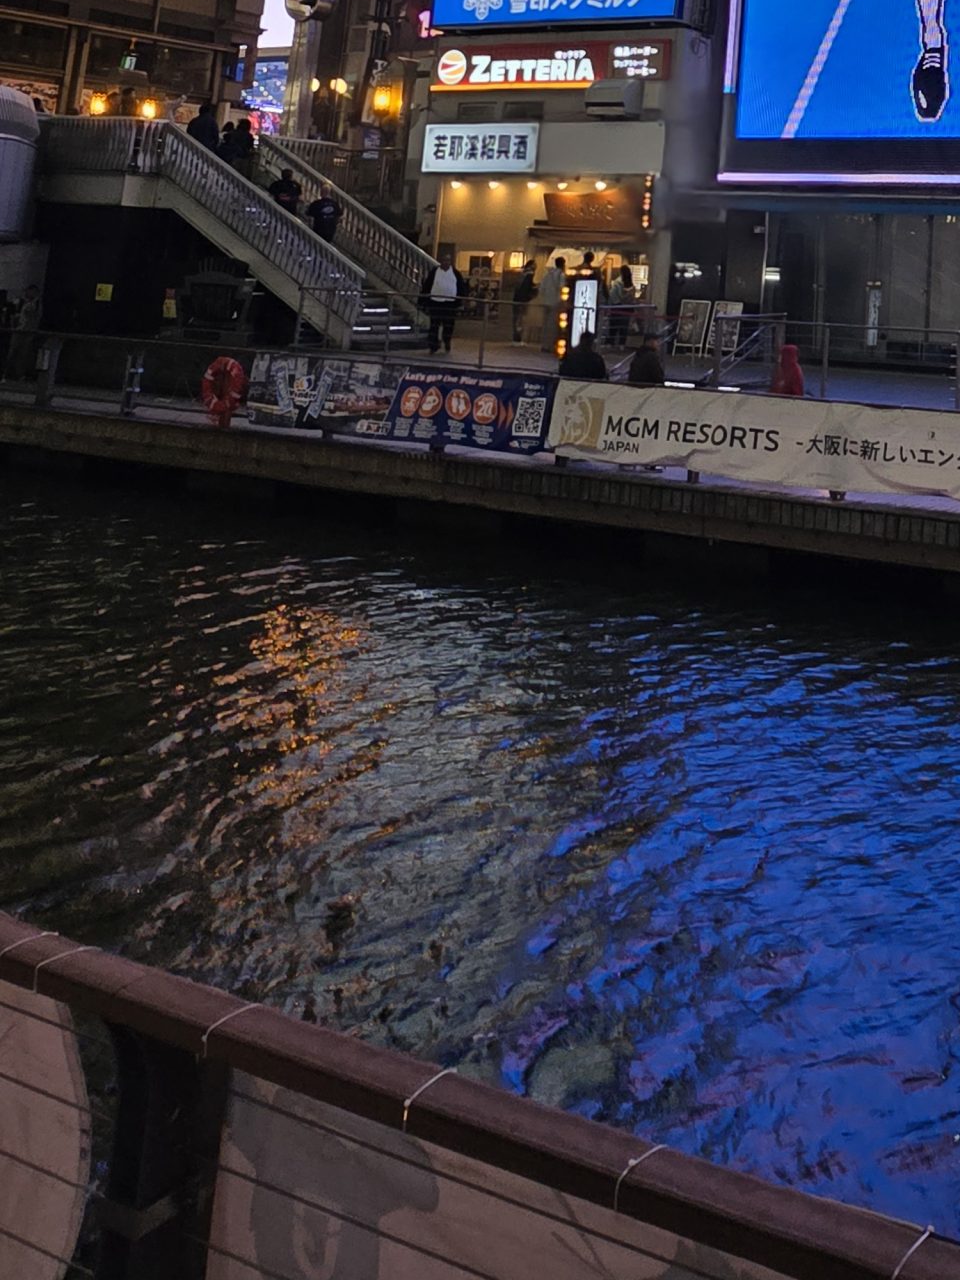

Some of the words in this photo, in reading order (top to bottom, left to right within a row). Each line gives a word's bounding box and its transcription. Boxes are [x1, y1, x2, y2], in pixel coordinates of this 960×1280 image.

[601, 439, 641, 455] JAPAN
[604, 415, 660, 441] MGM
[665, 419, 780, 453] RESORTS
